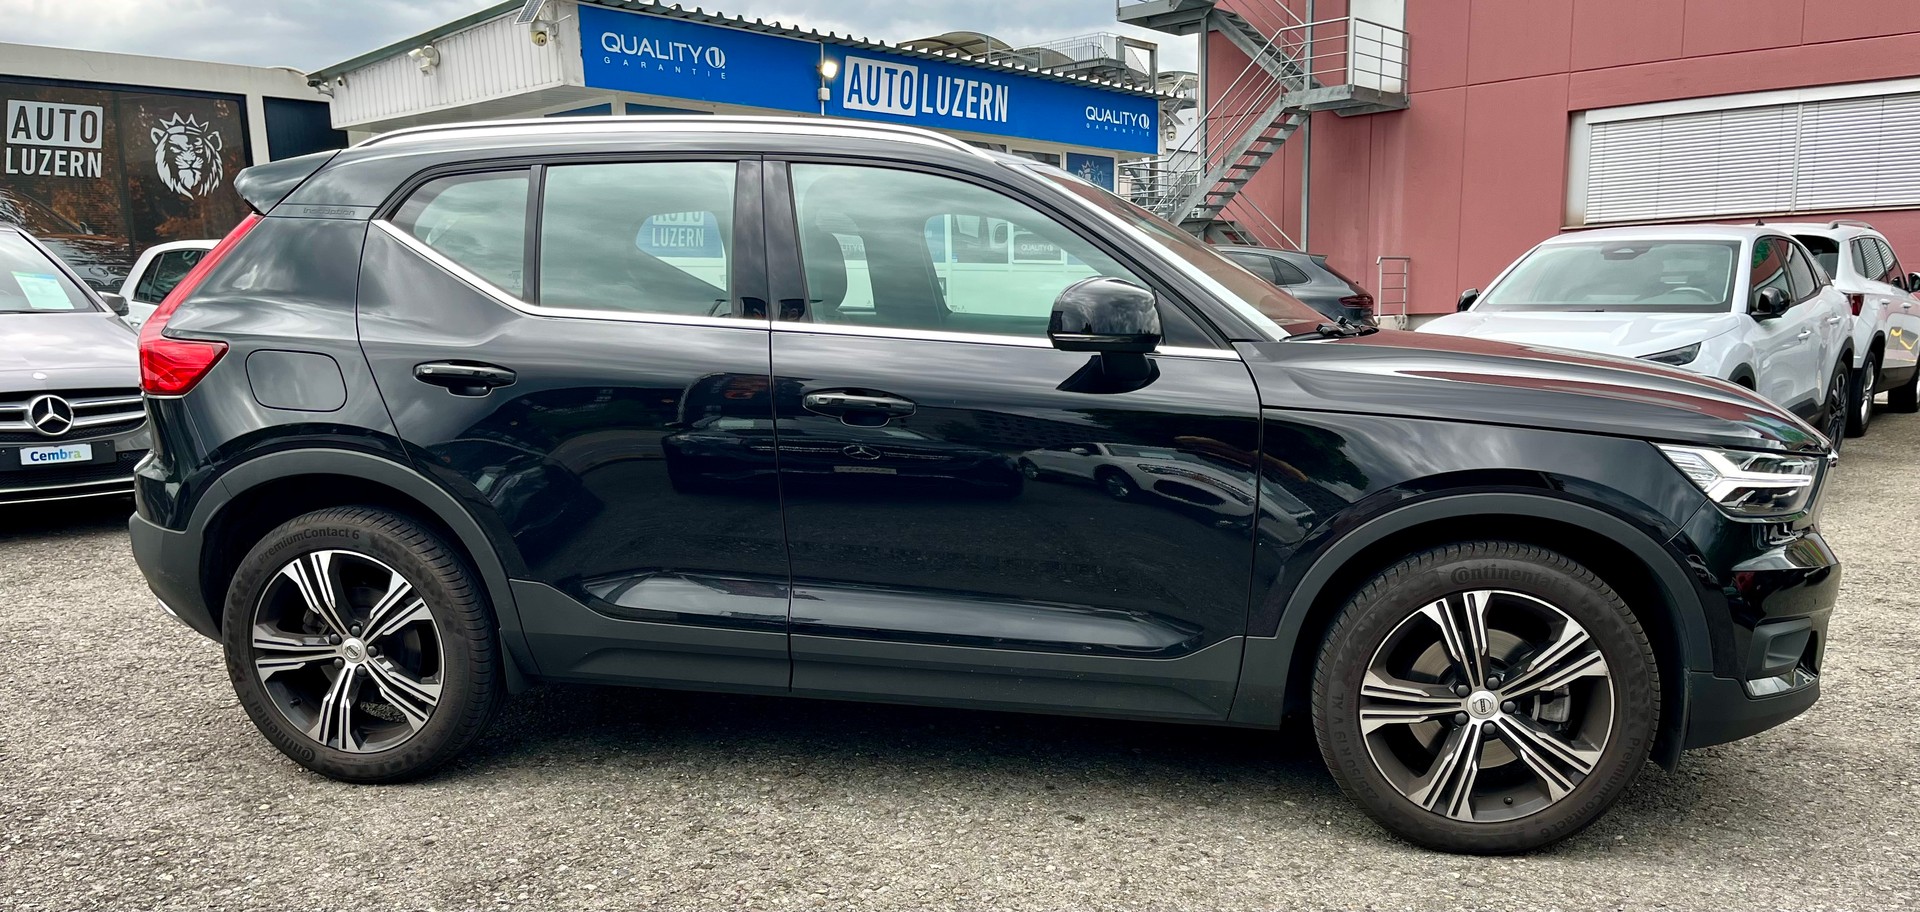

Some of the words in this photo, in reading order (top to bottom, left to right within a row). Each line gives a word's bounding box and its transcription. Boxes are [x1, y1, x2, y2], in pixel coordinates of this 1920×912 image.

[601, 32, 702, 64] QUALITY
[604, 56, 726, 80] GARANTIE
[847, 63, 914, 110] AUTO
[922, 74, 1008, 122] LUZERN
[11, 106, 98, 143] AUTO
[1085, 106, 1138, 126] QUALITY
[6, 147, 102, 178] LUZERN
[652, 228, 704, 247] LUZERN
[30, 449, 82, 462] Cembra
[259, 527, 350, 563] PremiumContact
[352, 530, 360, 540] 6
[249, 700, 316, 763] Continental
[1540, 827, 1551, 839] 6
